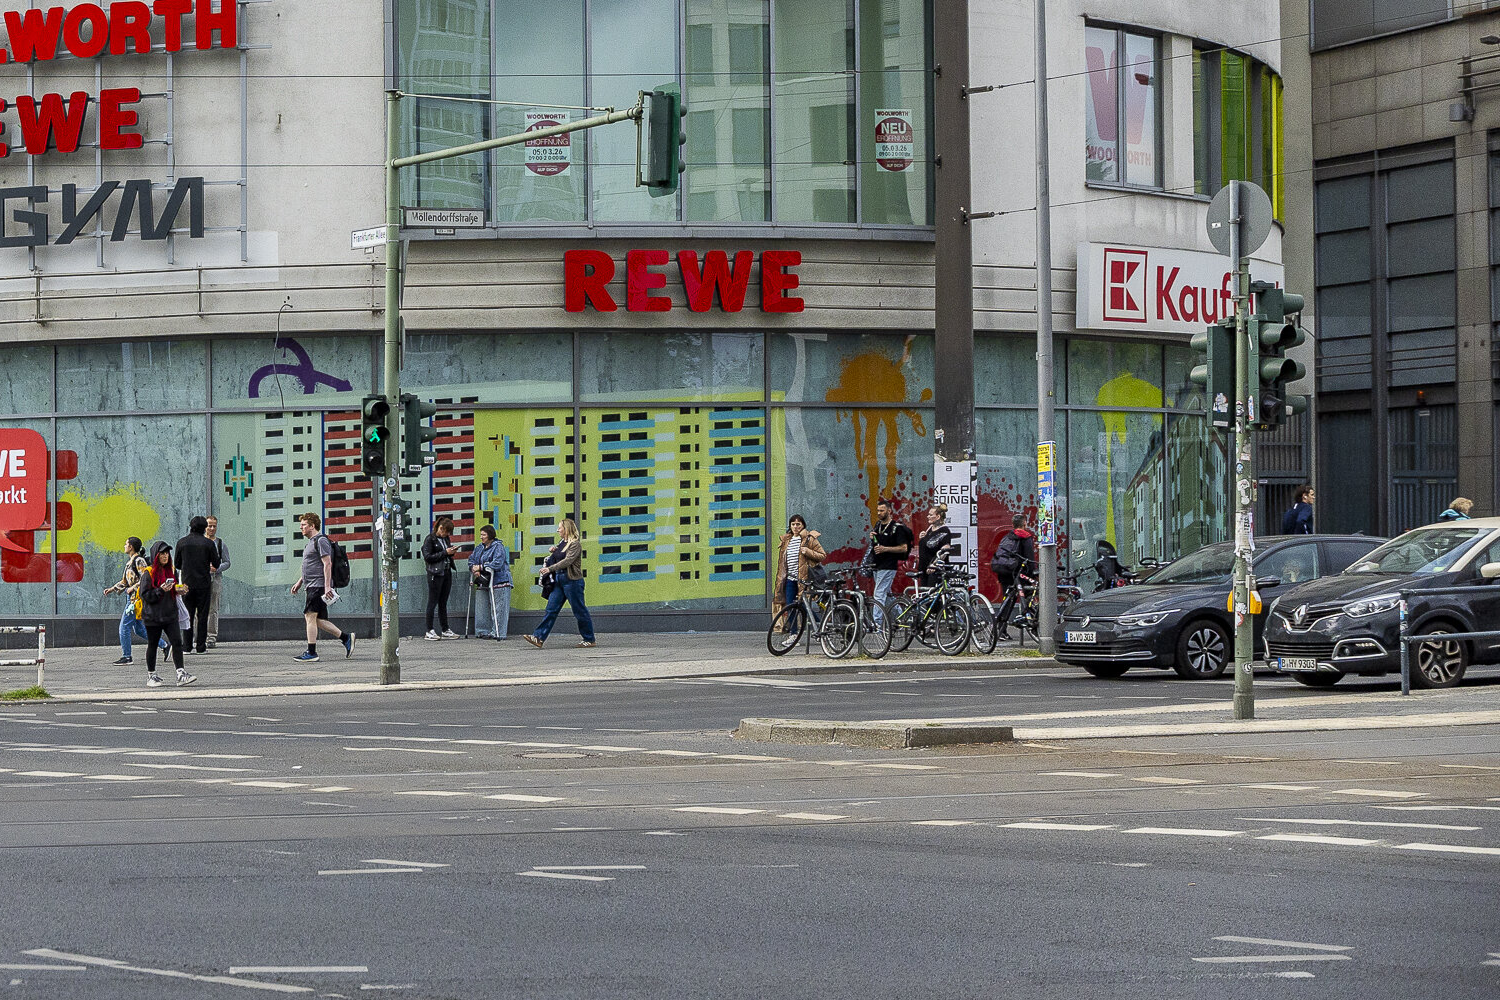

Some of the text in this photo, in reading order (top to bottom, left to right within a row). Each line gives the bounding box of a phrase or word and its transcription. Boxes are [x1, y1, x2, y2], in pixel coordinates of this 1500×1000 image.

[881, 123, 907, 134] NEU
[411, 212, 479, 225] Möllendorffstraße
[563, 249, 805, 313] REWE
[934, 485, 969, 495] KEEP
[1298, 659, 1315, 669] 9303
